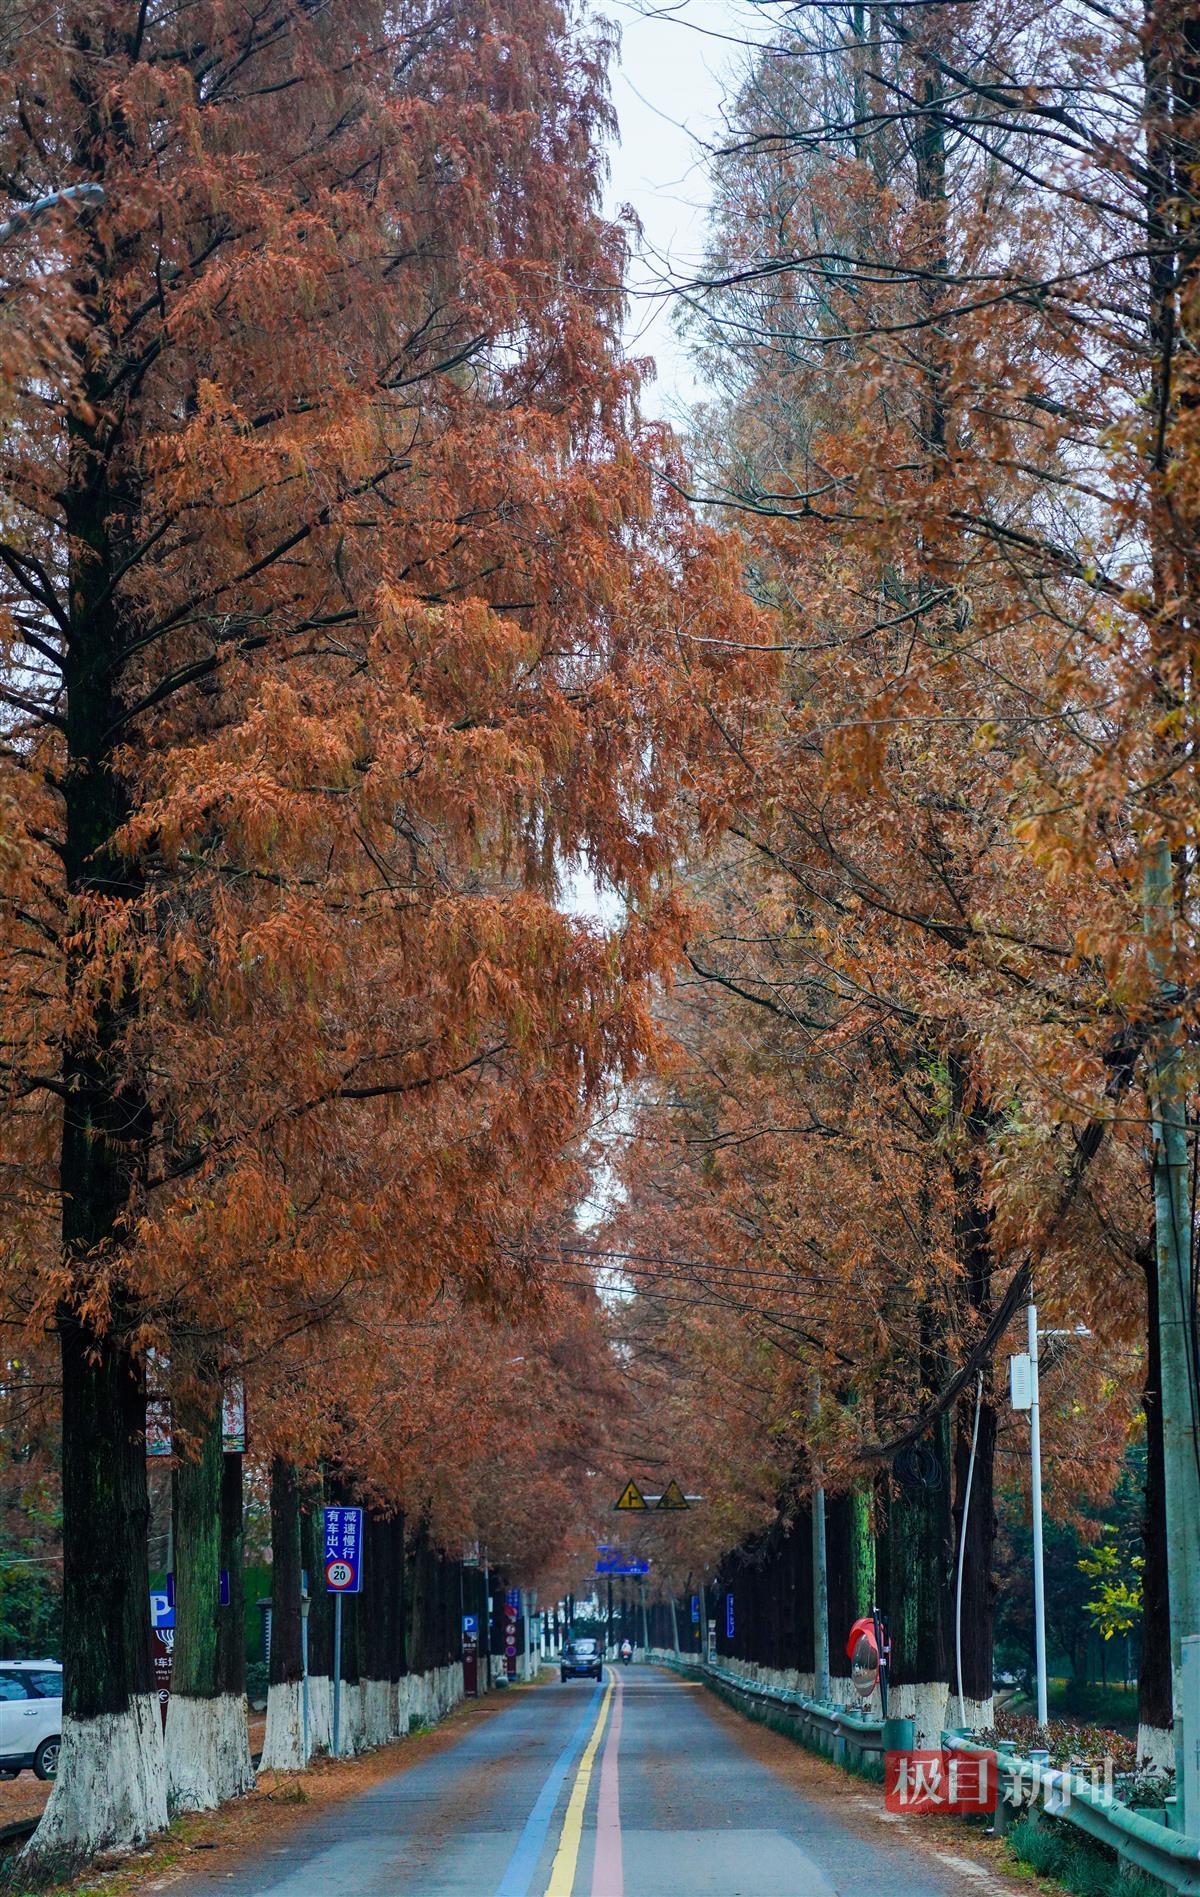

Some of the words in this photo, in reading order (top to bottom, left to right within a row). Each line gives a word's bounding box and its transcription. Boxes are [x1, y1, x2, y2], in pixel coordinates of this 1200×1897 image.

[326, 1510, 340, 1559] 有车出入
[342, 1511, 357, 1560] 减速慢行
[333, 1571, 346, 1581] 20
[150, 1595, 172, 1627] P
[464, 1617, 474, 1631] P
